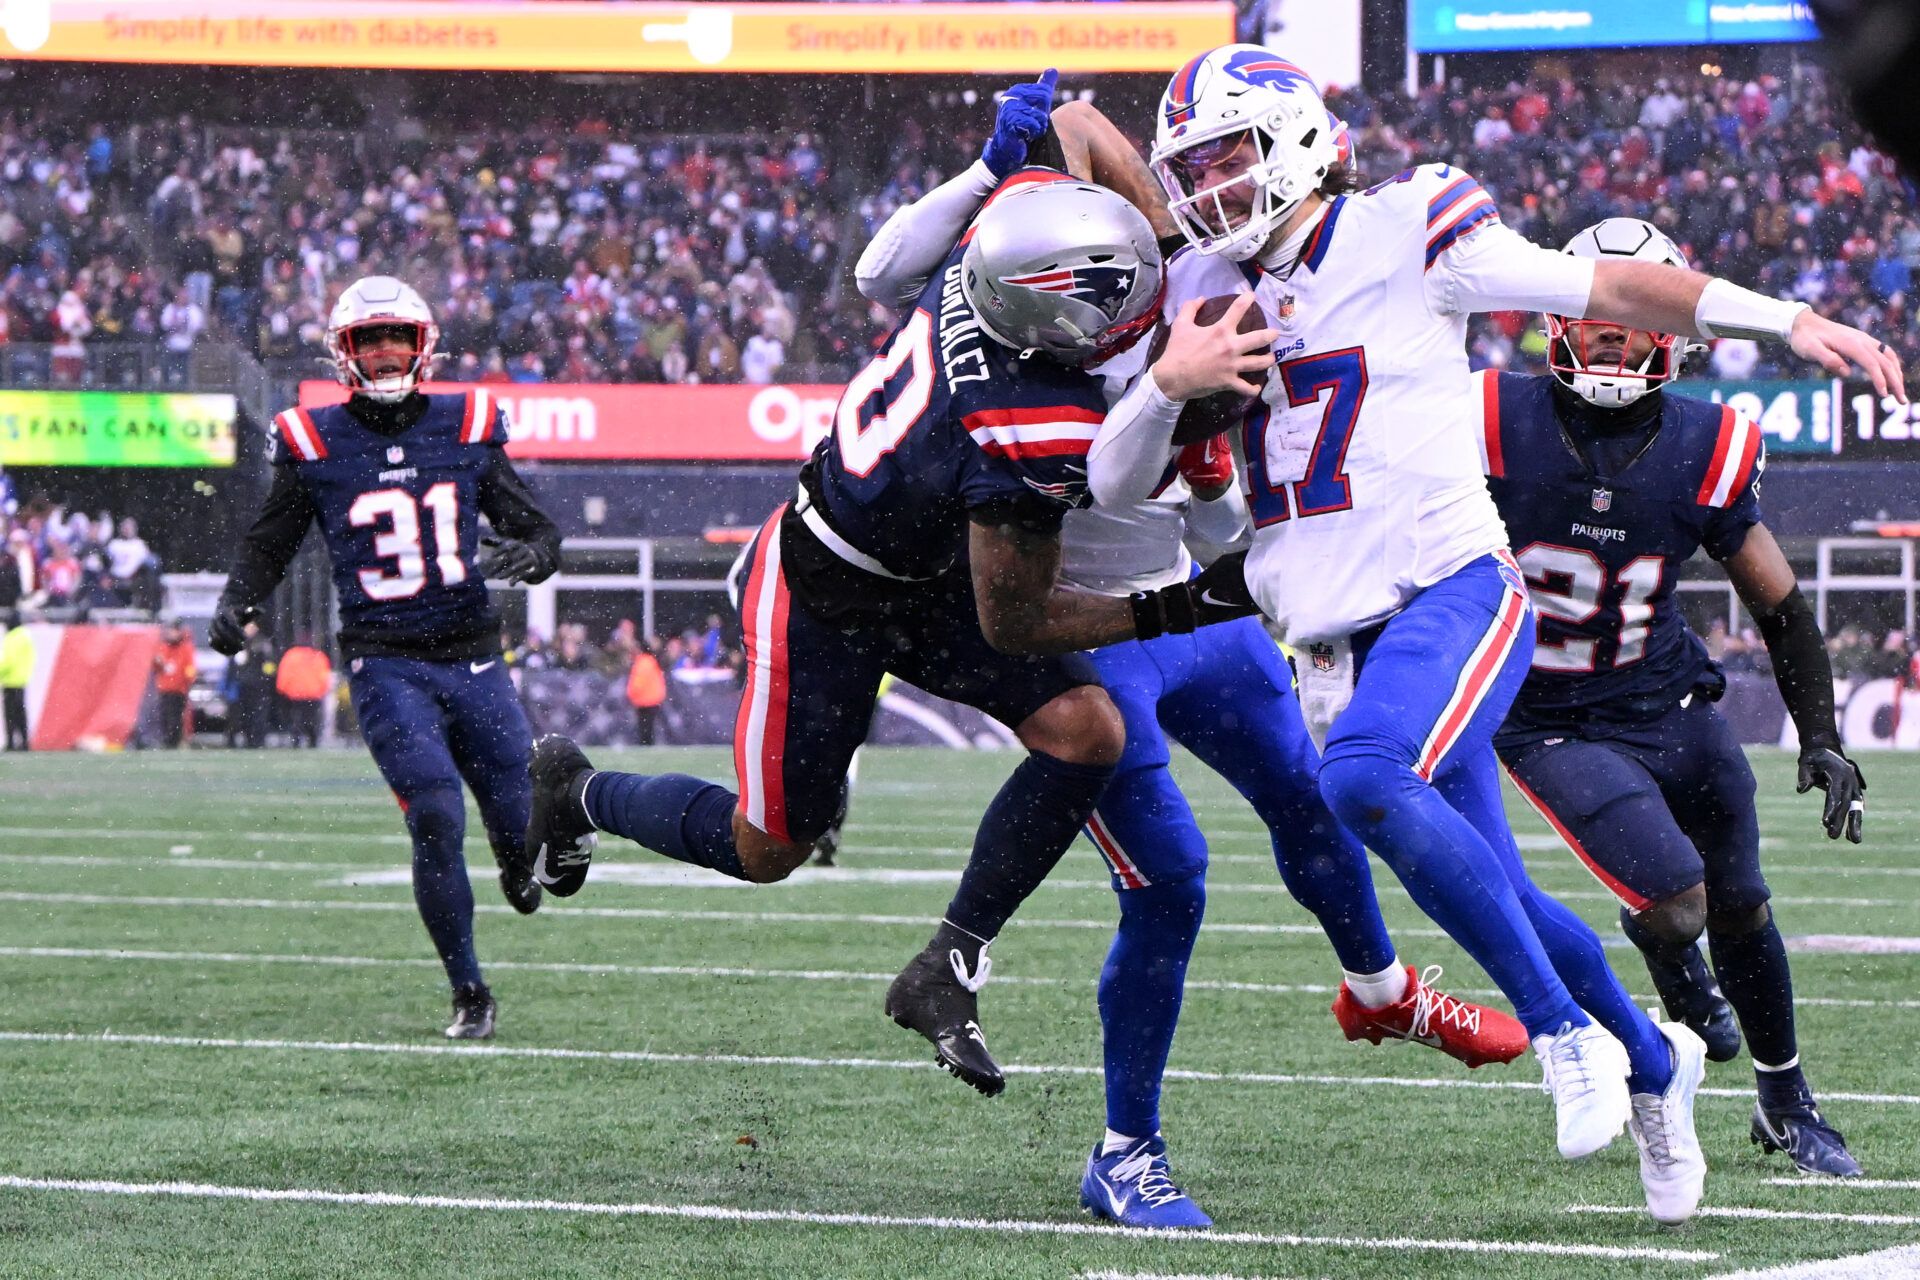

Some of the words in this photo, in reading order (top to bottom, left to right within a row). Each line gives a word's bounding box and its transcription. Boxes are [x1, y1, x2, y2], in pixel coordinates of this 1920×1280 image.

[102, 12, 224, 46] Simplify
[236, 14, 284, 44] life
[294, 17, 358, 45] with
[368, 18, 499, 47] diabetes
[785, 22, 907, 53] Simplify
[917, 22, 965, 49] life
[972, 24, 1037, 50] with
[1047, 24, 1178, 51] diabetes
[29, 417, 89, 439] FAN
[103, 417, 168, 439] CAN
[836, 306, 937, 479] 0
[1242, 345, 1370, 531] 17
[349, 482, 468, 601] 31
[1571, 522, 1627, 542] PATRIOTS
[1514, 541, 1666, 673] 21
